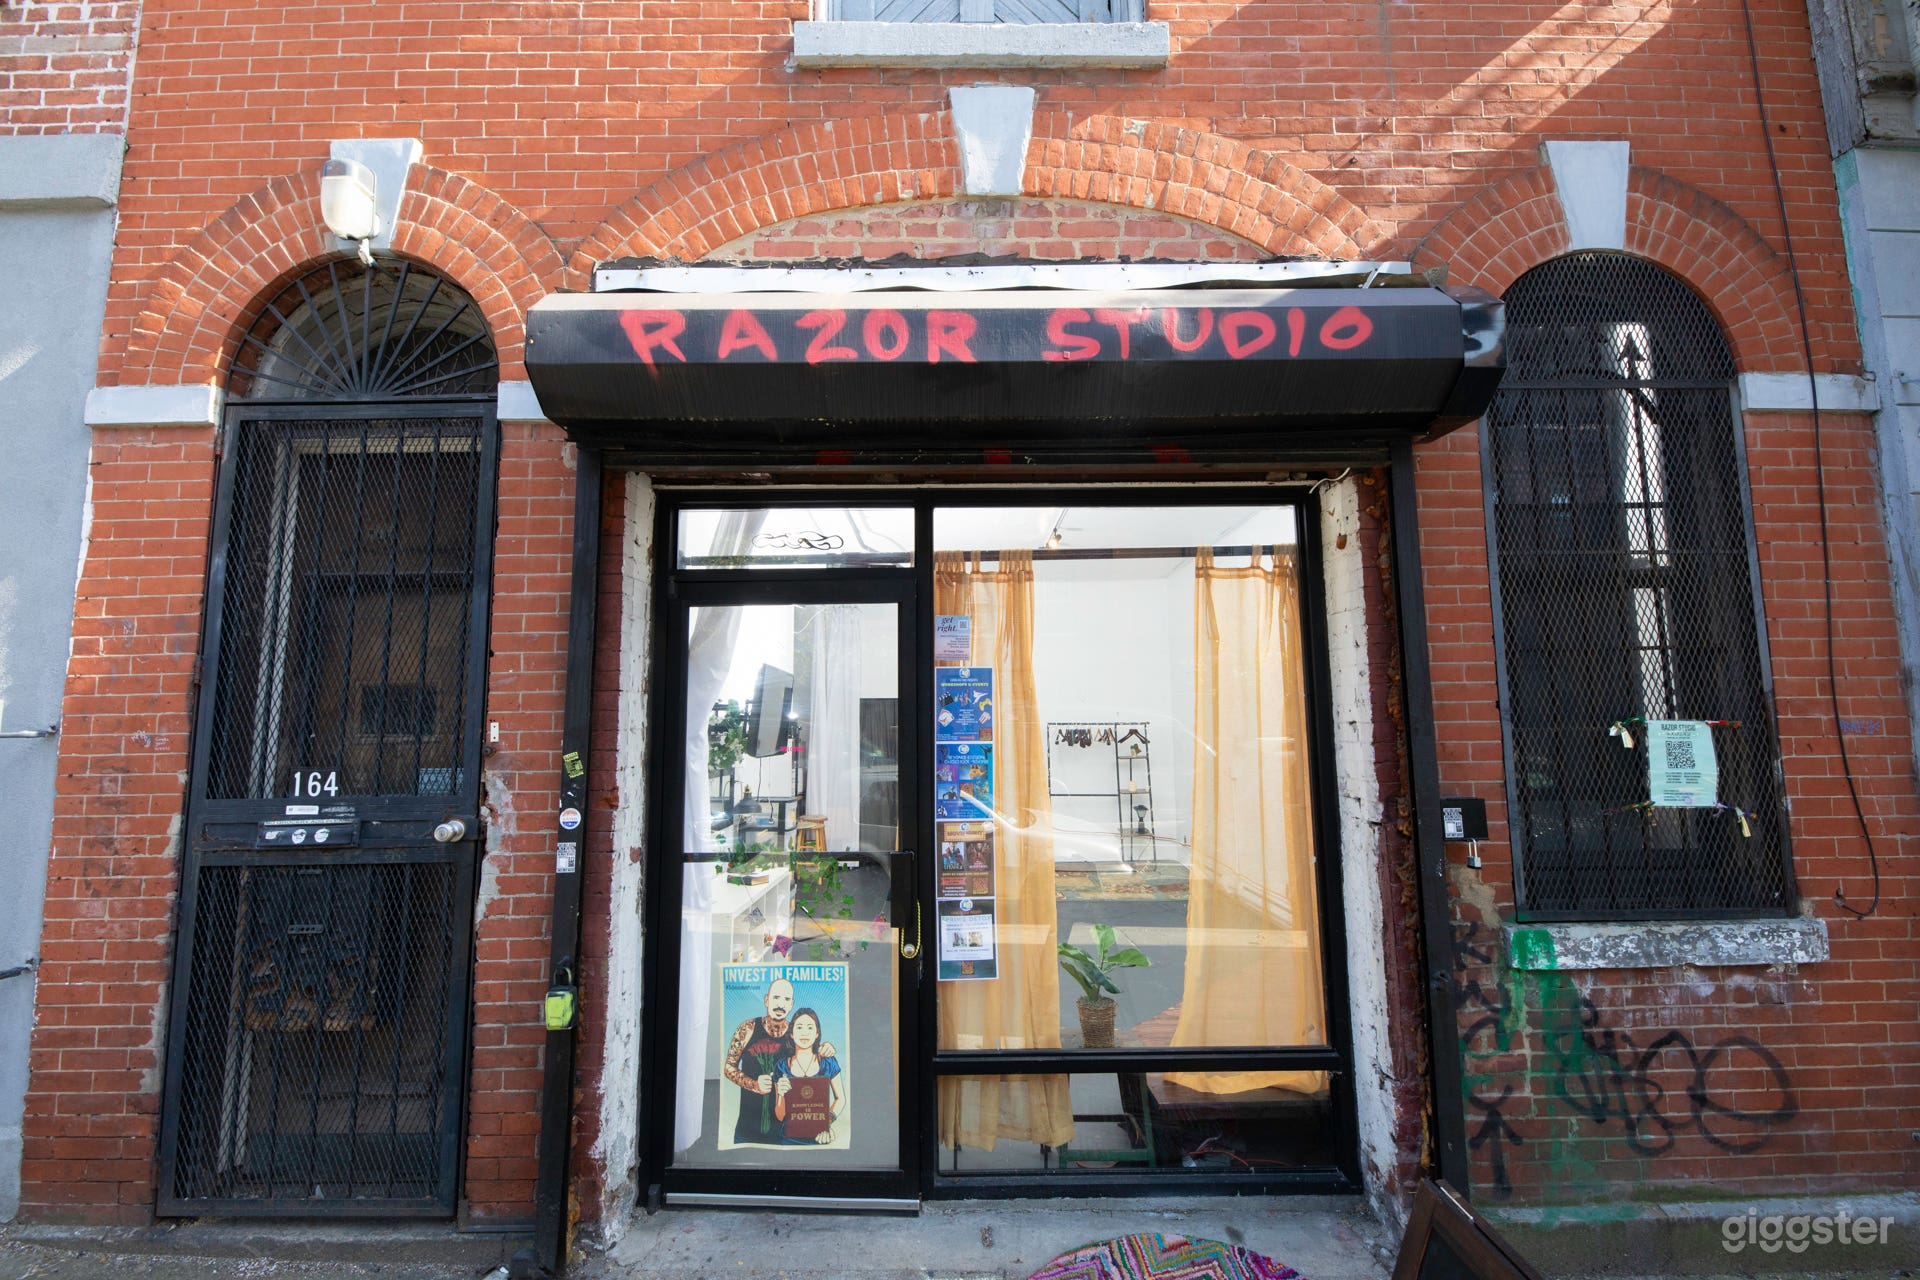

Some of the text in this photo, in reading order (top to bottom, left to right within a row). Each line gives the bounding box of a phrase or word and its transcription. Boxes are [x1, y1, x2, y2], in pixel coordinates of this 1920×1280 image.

[619, 306, 1374, 374] RAZOR STUDIO
[294, 771, 339, 797] 164
[724, 967, 844, 983] INVEST IN FAMILIES!
[790, 1112, 826, 1121] POWER
